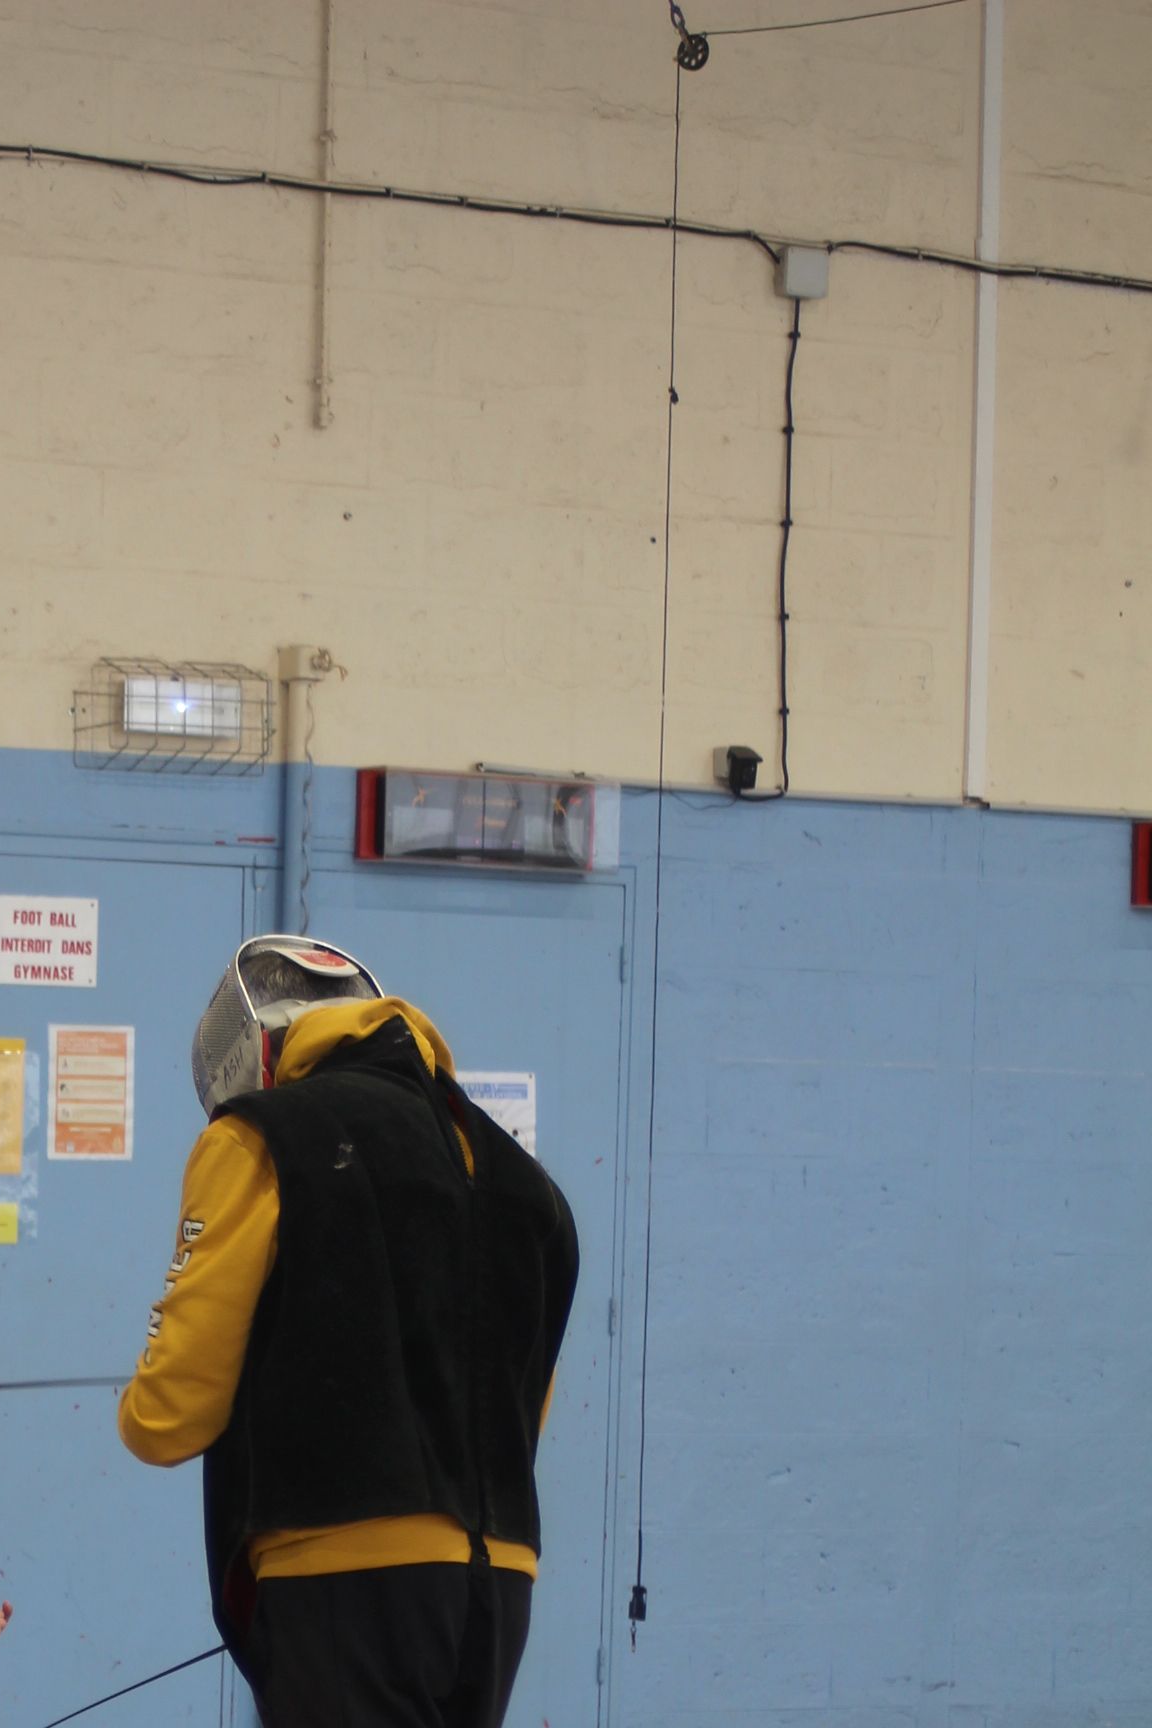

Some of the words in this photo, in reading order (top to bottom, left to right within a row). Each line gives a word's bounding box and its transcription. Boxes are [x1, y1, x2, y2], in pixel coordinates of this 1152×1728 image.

[13, 910, 43, 926] FOOT
[49, 911, 77, 928] BALL
[1, 937, 52, 954] INTERDIT
[61, 940, 92, 955] DANS
[14, 964, 75, 981] GYMNASE
